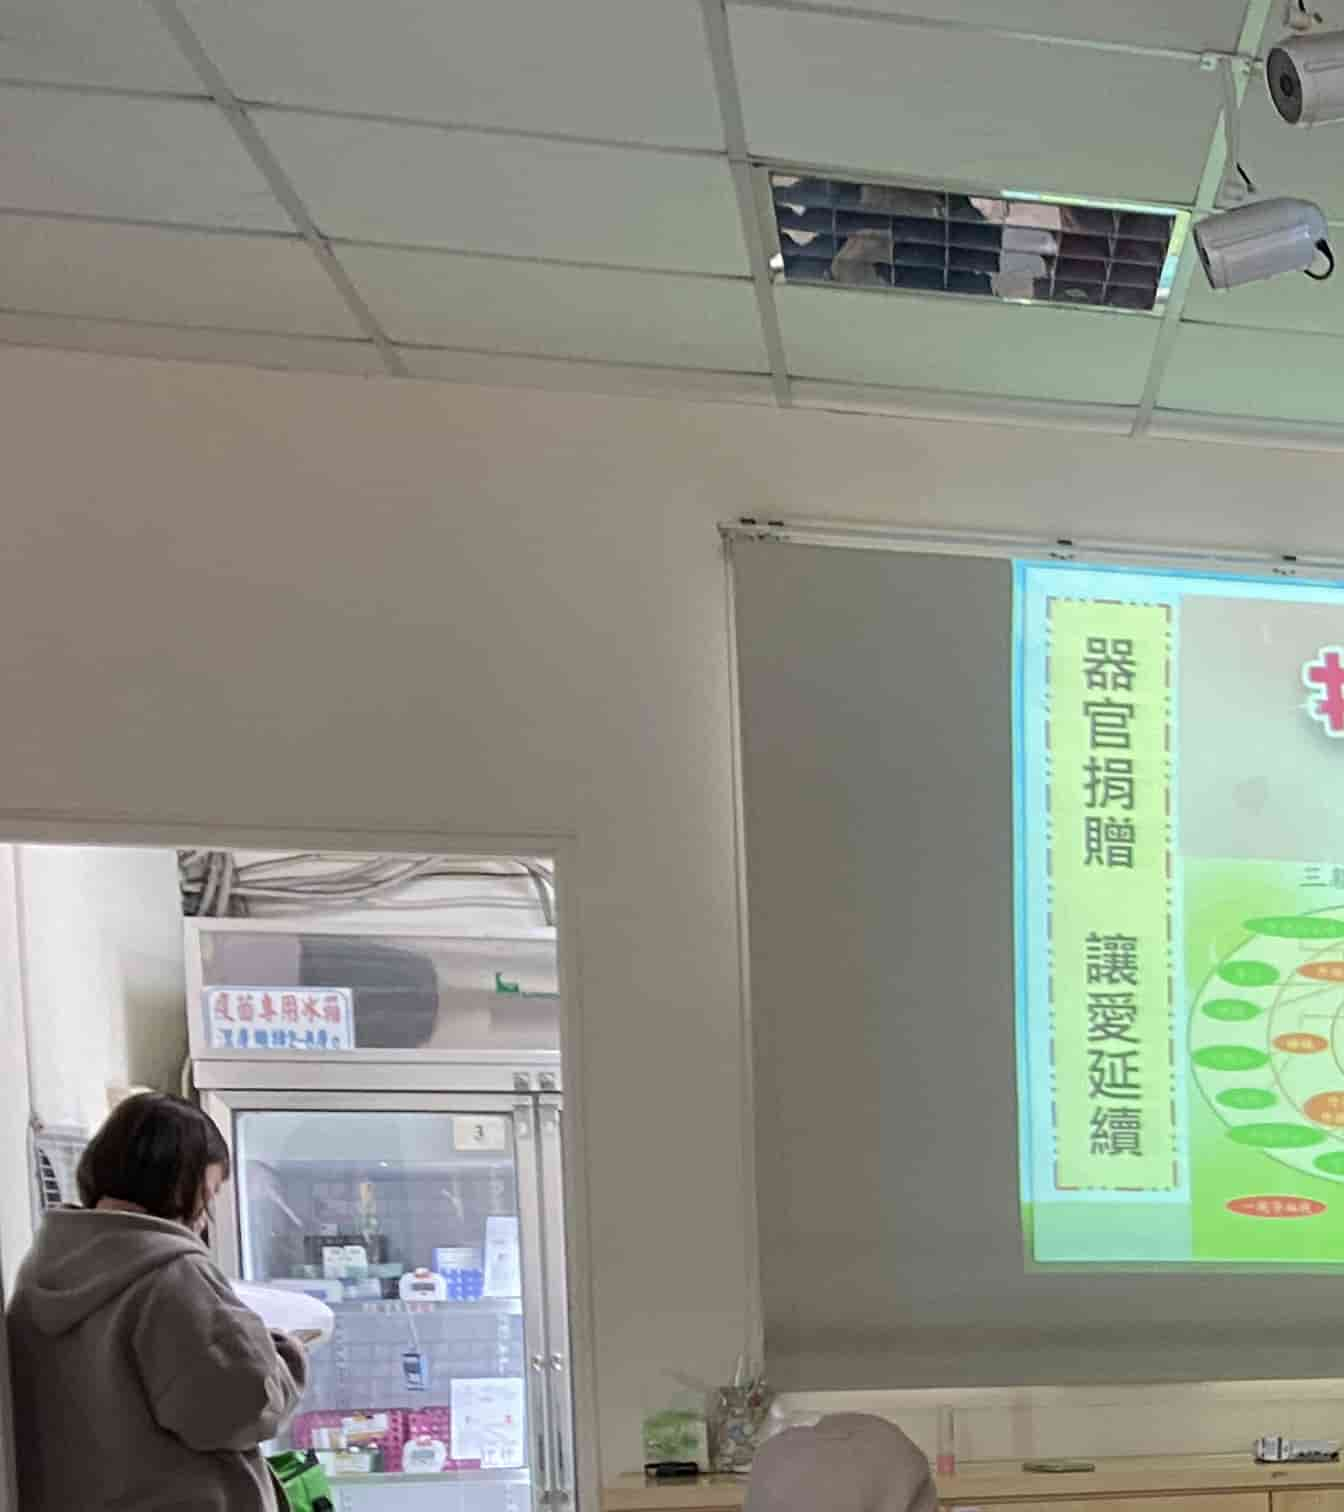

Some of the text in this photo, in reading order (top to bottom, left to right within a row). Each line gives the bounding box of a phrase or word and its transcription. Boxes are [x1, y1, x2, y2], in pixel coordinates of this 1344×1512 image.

[1081, 636, 1143, 1158] 器官捐贈 讓愛延續
